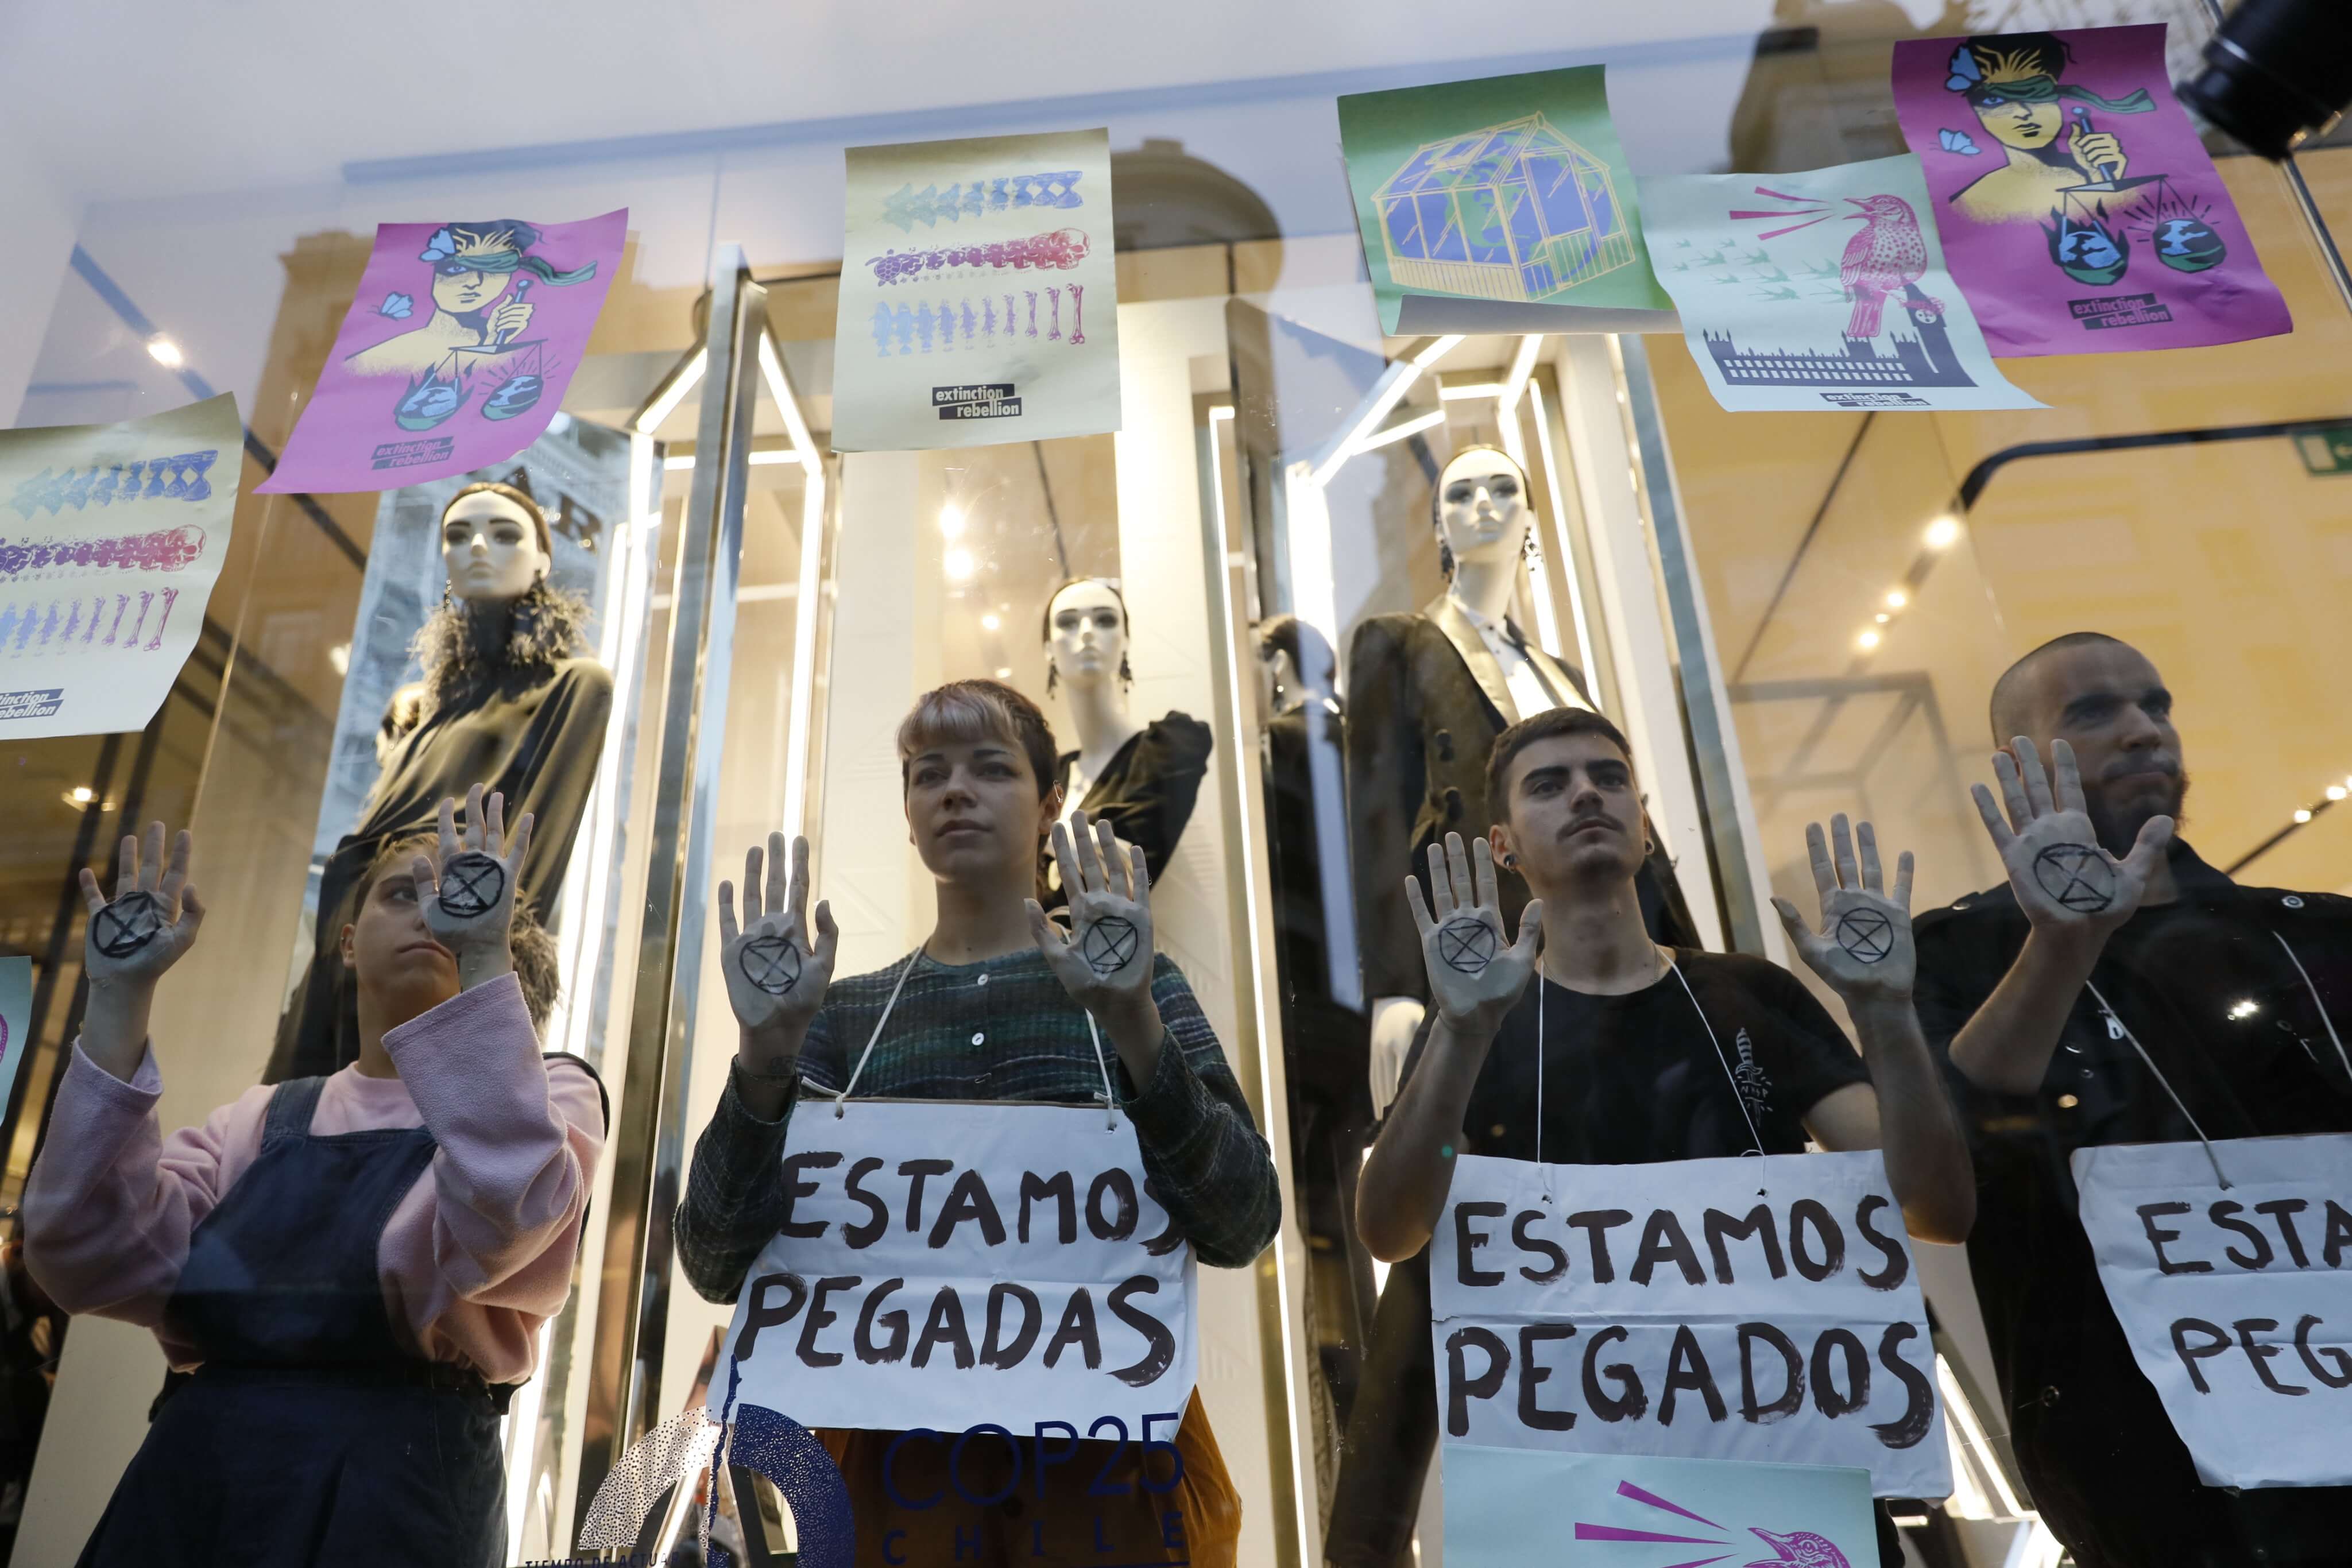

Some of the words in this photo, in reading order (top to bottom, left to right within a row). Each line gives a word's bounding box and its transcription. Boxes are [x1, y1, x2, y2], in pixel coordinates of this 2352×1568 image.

[2074, 297, 2146, 314] extinction
[2101, 309, 2169, 327] rebellion
[935, 385, 1004, 401] extinction
[1826, 393, 1901, 401] extinction
[957, 400, 1019, 417] rebellion
[377, 440, 442, 456] extinction
[389, 450, 450, 466] rebellion
[1454, 1195, 1909, 1291] ESTAMOS
[734, 1273, 1175, 1388] PEGADAS
[2170, 1314, 2352, 1396] PEG
[1445, 1322, 1935, 1449] PEGADOS
[883, 1412, 1183, 1511] COP25
[881, 1511, 1185, 1565] CHILE
